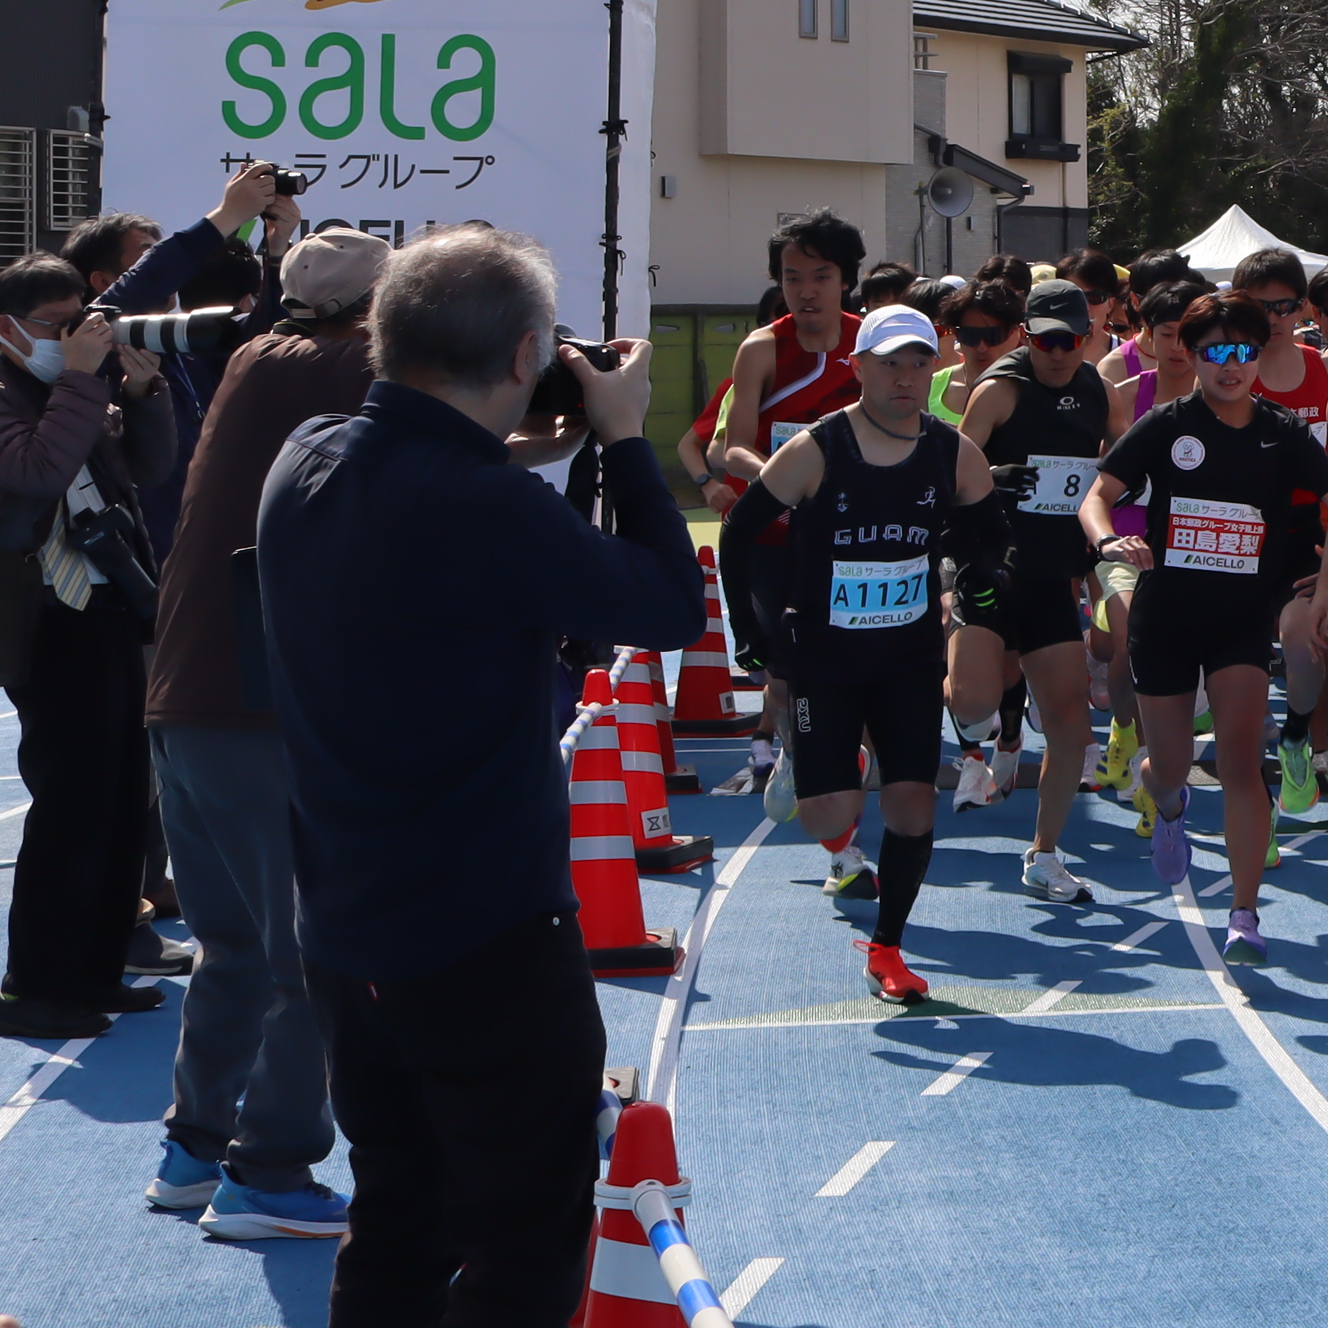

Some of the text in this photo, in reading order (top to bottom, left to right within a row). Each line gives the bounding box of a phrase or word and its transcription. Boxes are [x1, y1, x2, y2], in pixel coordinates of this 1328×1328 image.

[221, 30, 497, 142] sala
[1063, 474, 1081, 498] 8
[1042, 503, 1078, 513] AICELL
[834, 524, 930, 546] GUAM
[1172, 527, 1261, 556] 田島愛梨
[1192, 554, 1245, 570] AICELLO
[858, 611, 914, 626] AICELLO
[796, 697, 812, 733] 2XU
